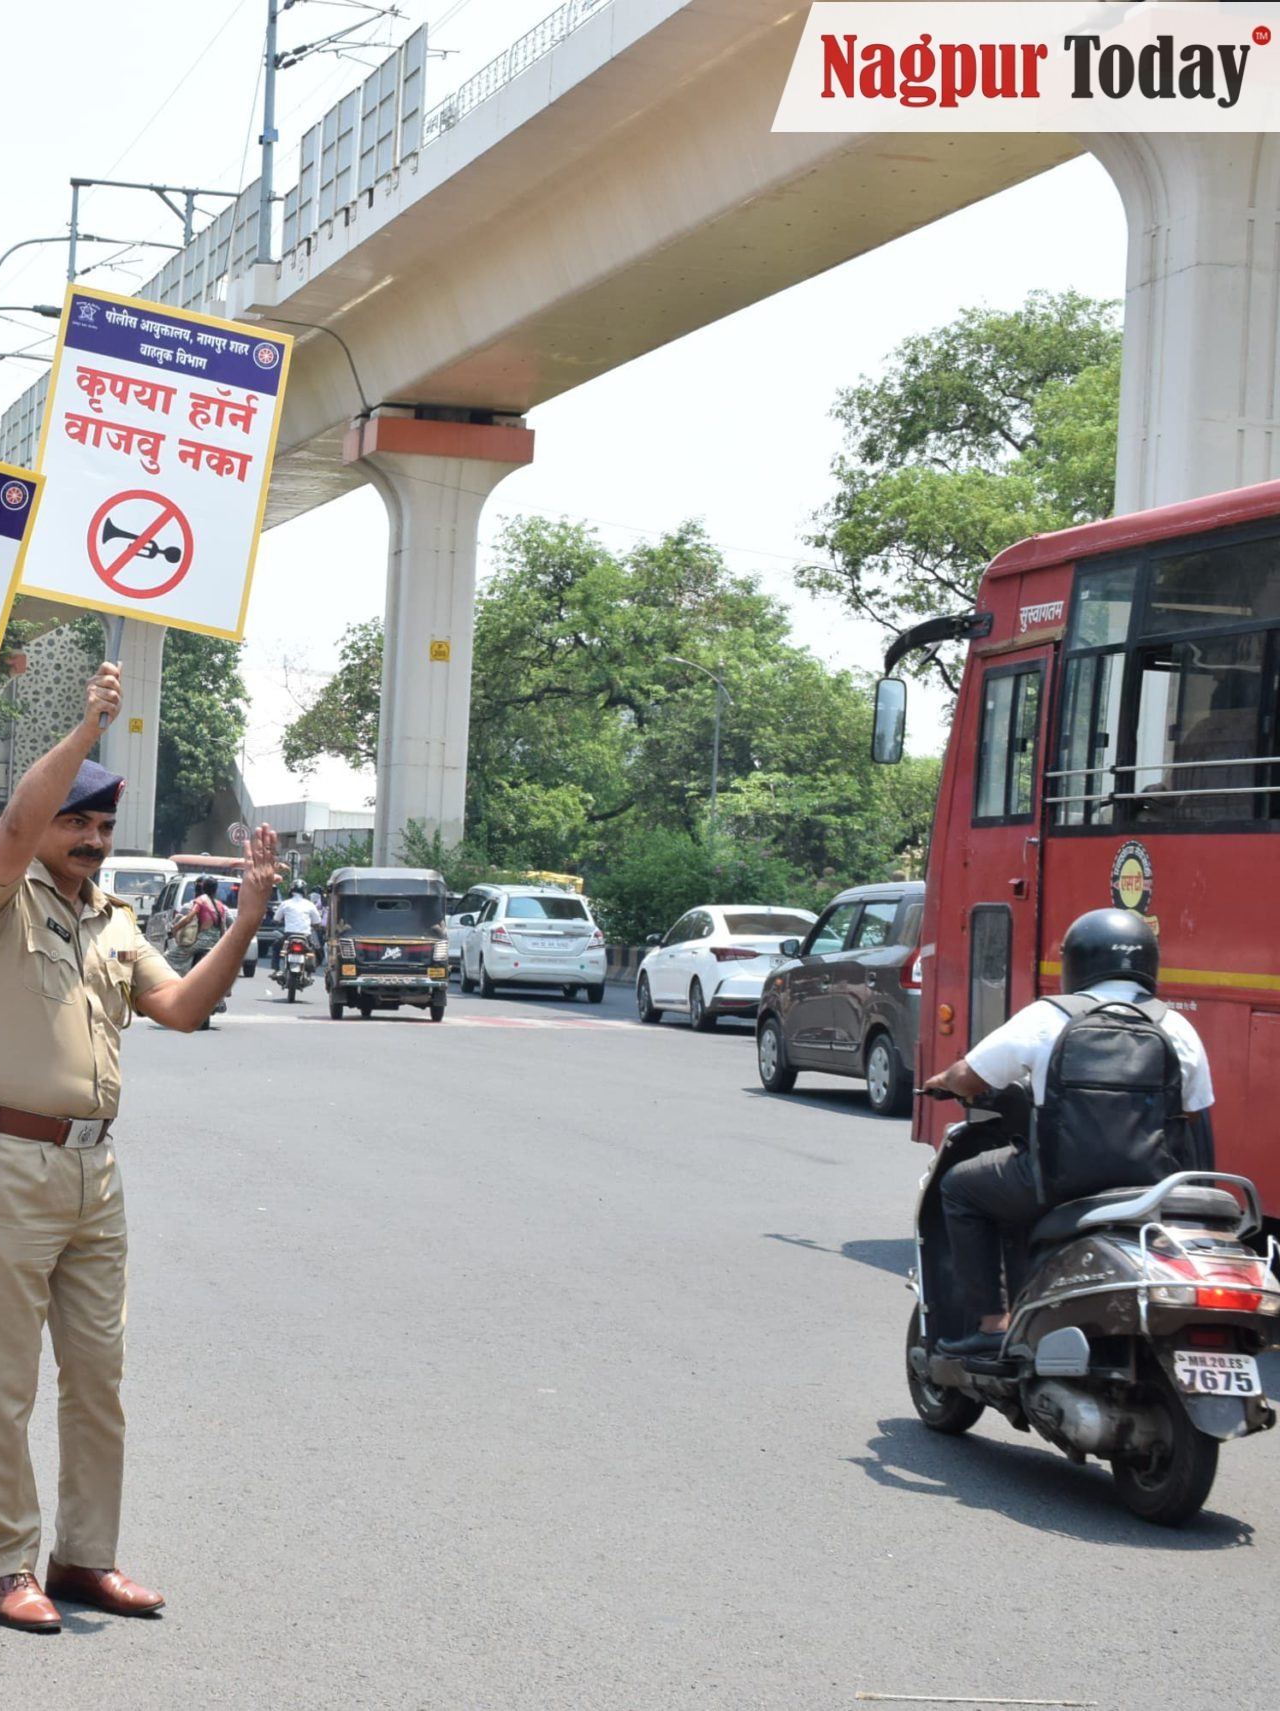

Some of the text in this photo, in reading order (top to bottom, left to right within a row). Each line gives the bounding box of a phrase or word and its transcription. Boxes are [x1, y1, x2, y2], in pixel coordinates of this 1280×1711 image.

[104, 308, 137, 329] पोलीस
[196, 332, 227, 354] नागपुर
[229, 340, 250, 356] शहर
[175, 348, 208, 370] विभाग
[76, 365, 259, 434] कृपया हॉर्न
[64, 412, 253, 483] वाजवु नका
[1182, 1369, 1253, 1393] 7675
